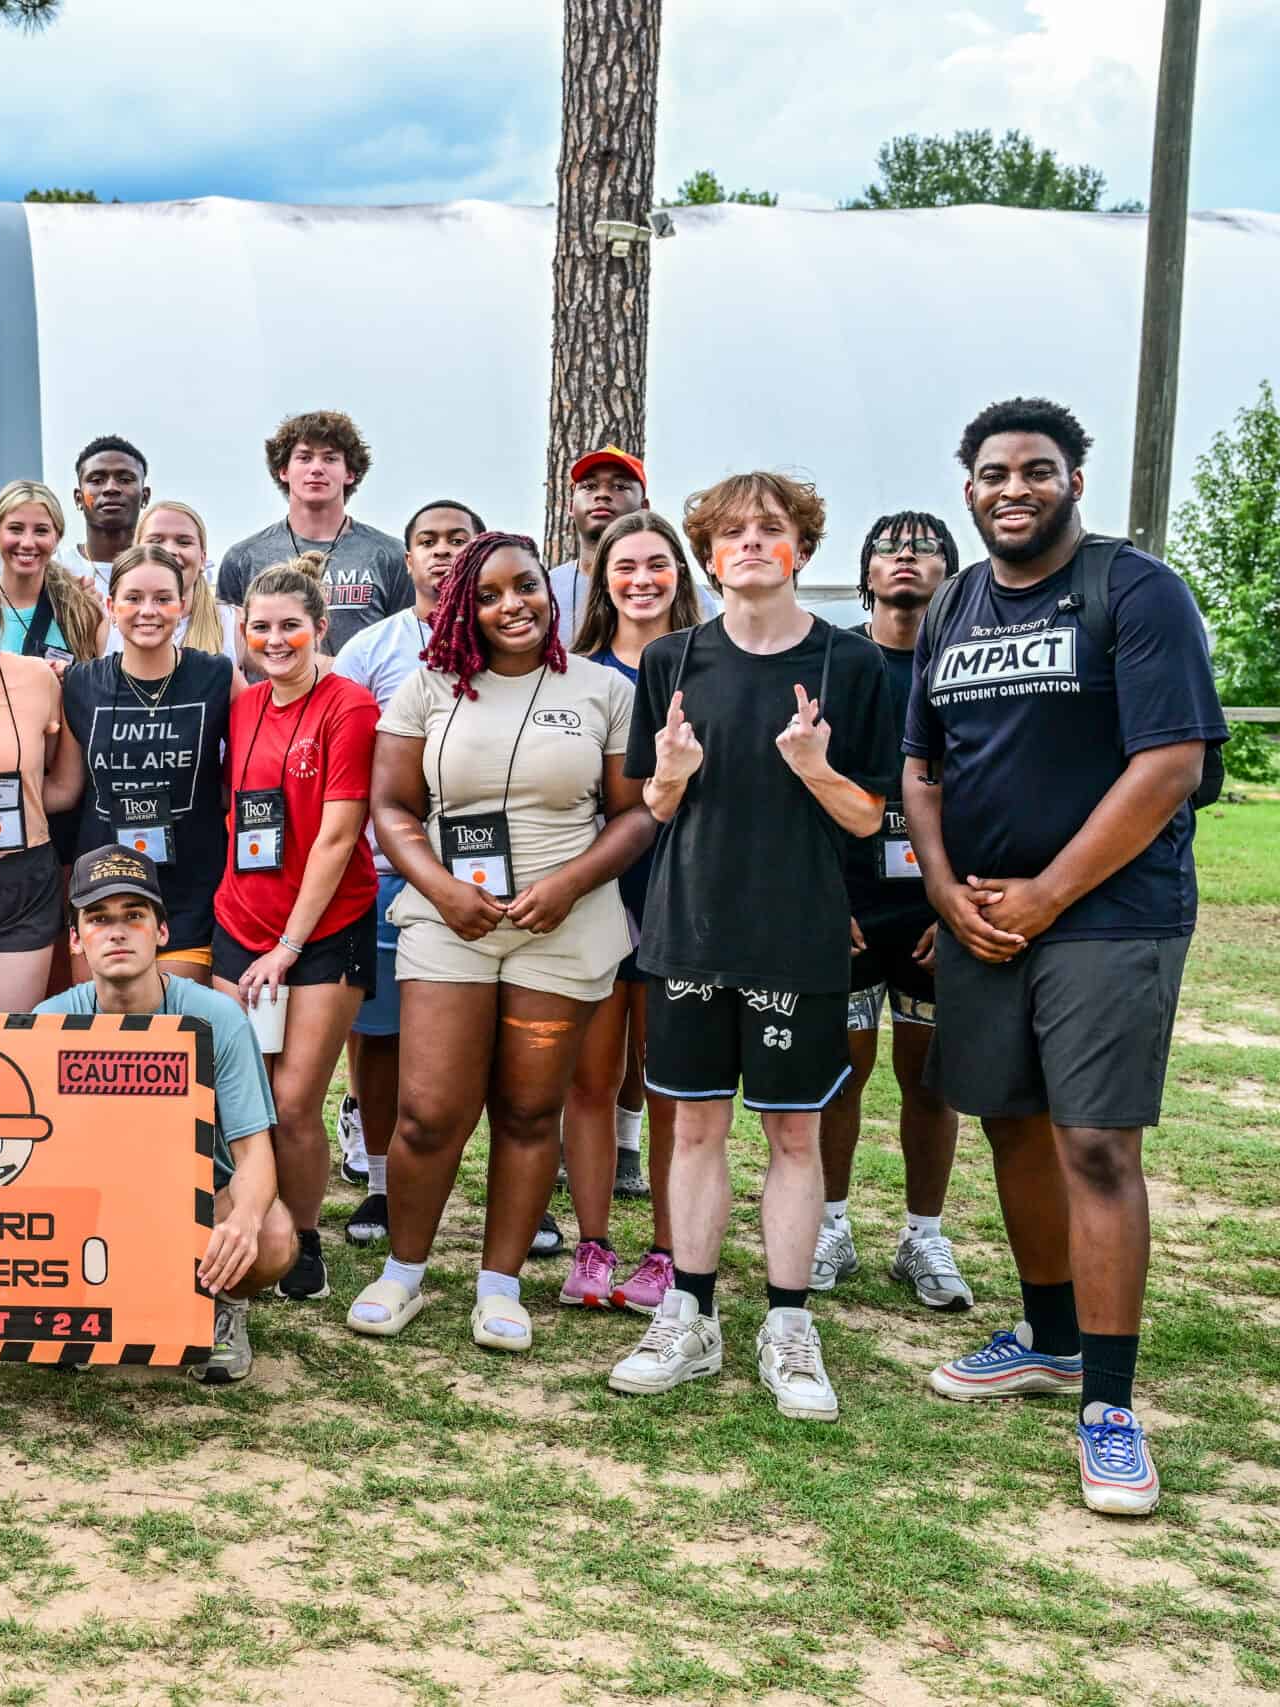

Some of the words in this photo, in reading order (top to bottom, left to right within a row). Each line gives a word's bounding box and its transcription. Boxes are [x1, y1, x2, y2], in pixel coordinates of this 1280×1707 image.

[336, 585, 374, 604] TIDE
[941, 637, 1063, 681] IMPACT
[930, 694, 950, 707] NEW
[953, 687, 997, 704] STUDENT
[999, 680, 1081, 697] ORIENTATION
[112, 722, 180, 741] UNTIL
[94, 752, 136, 770] ALL
[142, 750, 192, 769] ARE
[120, 798, 158, 815] TROY
[242, 801, 272, 817] TROY
[885, 812, 906, 828] TR
[452, 825, 494, 844] TROY
[763, 1025, 792, 1050] 23
[67, 1063, 181, 1084] CAUTION
